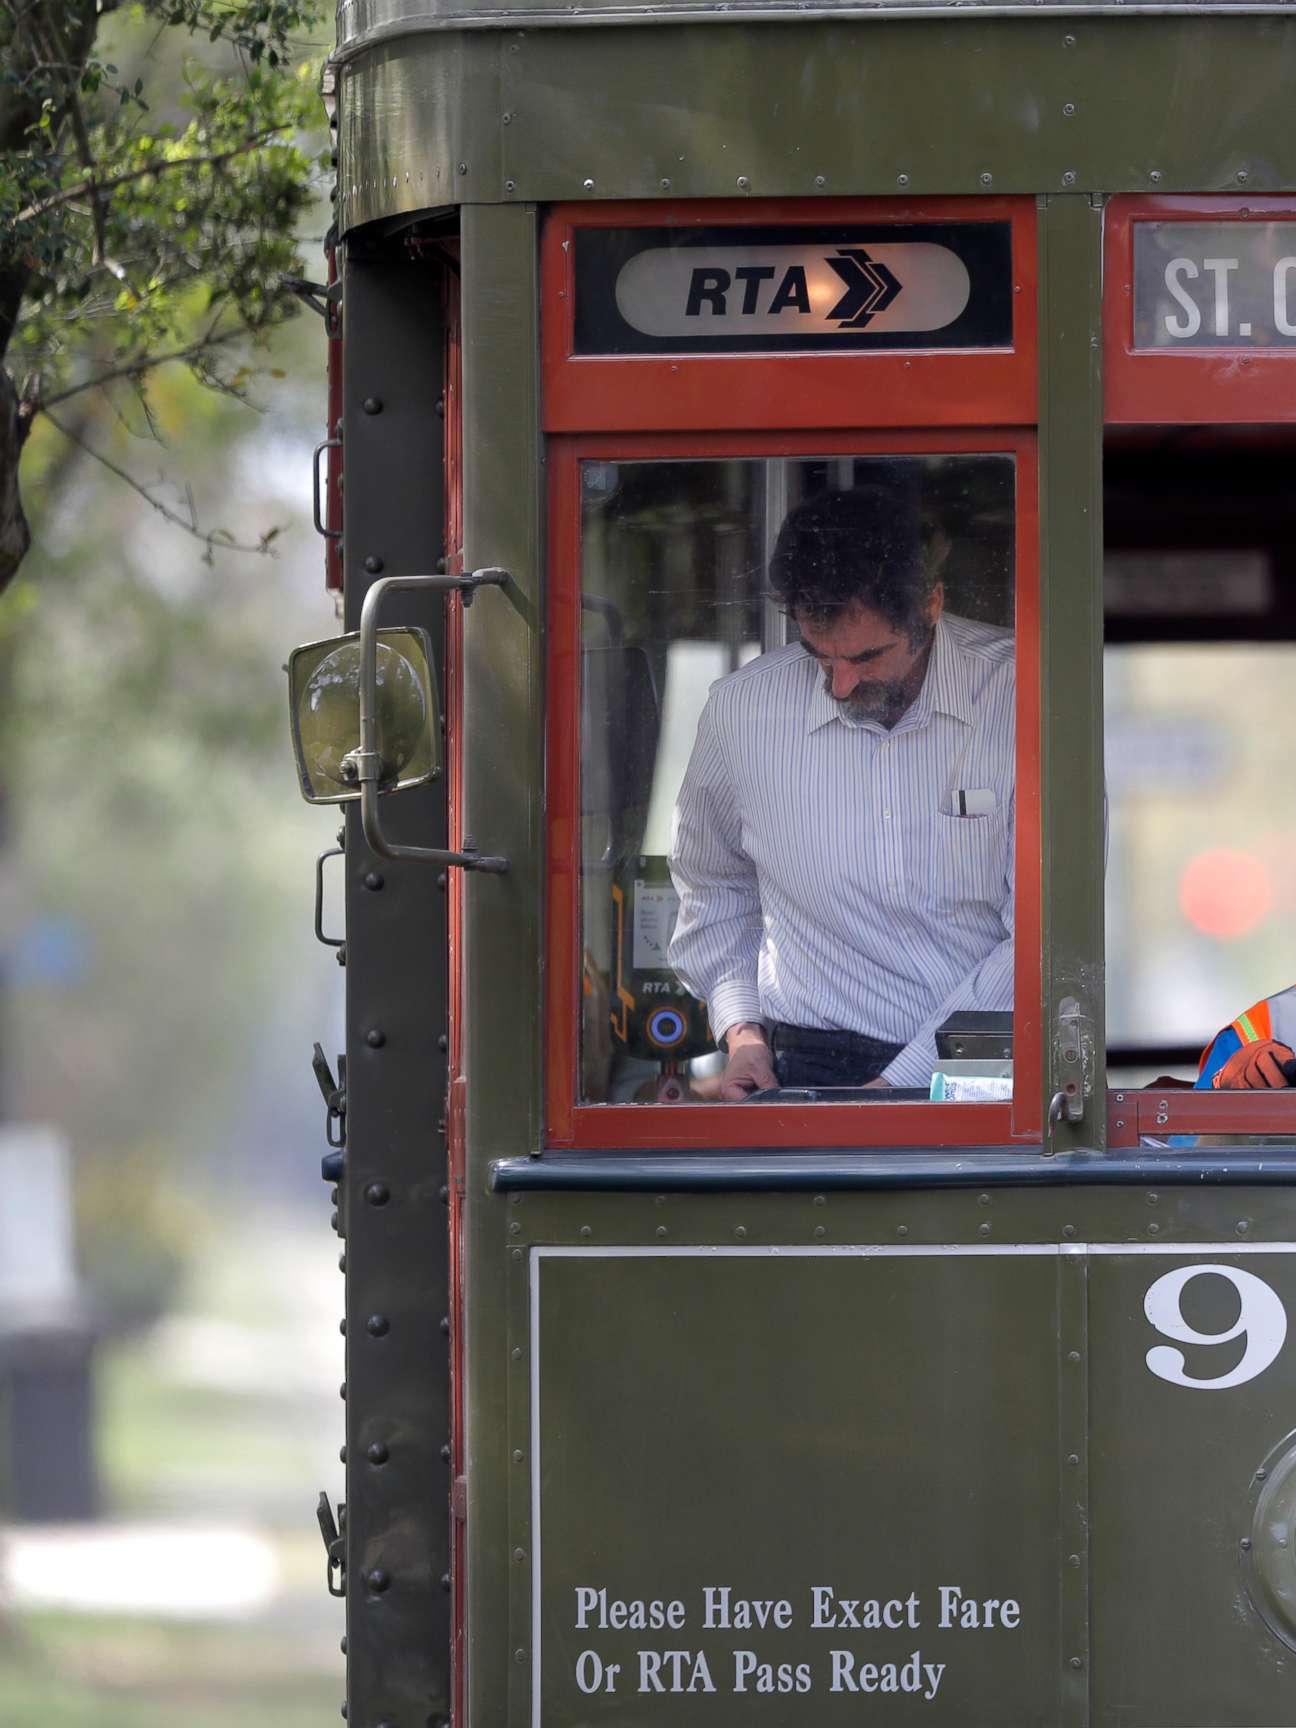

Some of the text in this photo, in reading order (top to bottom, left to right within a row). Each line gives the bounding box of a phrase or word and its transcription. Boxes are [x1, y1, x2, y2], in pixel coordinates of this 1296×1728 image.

[685, 264, 811, 317] RTA
[1163, 256, 1253, 339] ST.
[642, 981, 671, 994] RTA
[574, 1586, 1021, 1630] Please Have Exact Fare
[575, 1650, 946, 1701] Or RTA Pass Ready
